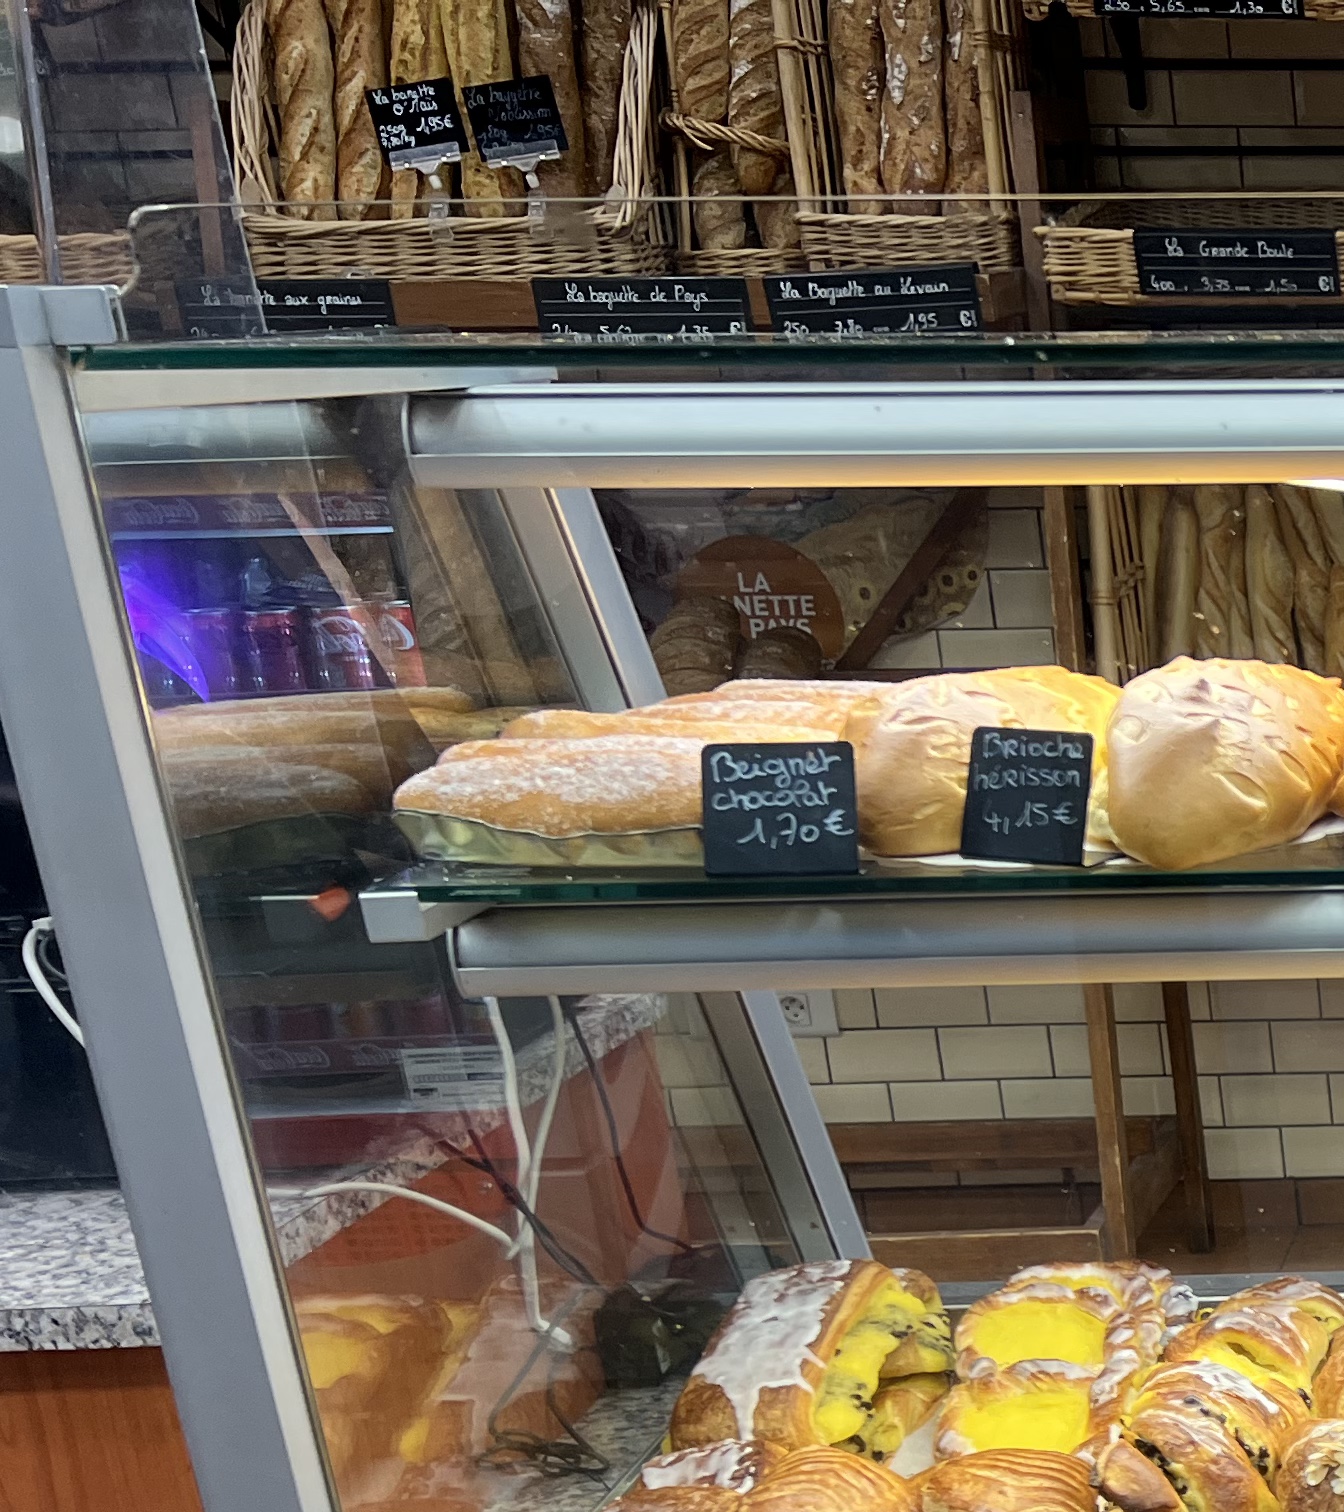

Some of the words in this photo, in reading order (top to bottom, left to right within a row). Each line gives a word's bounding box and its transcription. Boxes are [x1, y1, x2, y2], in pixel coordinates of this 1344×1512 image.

[1200, 240, 1250, 258] Grande
[1256, 241, 1295, 259] Boule
[650, 286, 667, 303] de
[737, 571, 771, 593] LA
[710, 748, 841, 788] Beignet
[712, 779, 837, 811] chocolat
[736, 809, 854, 849] 1,70€
[984, 800, 1078, 835] 4,15€
